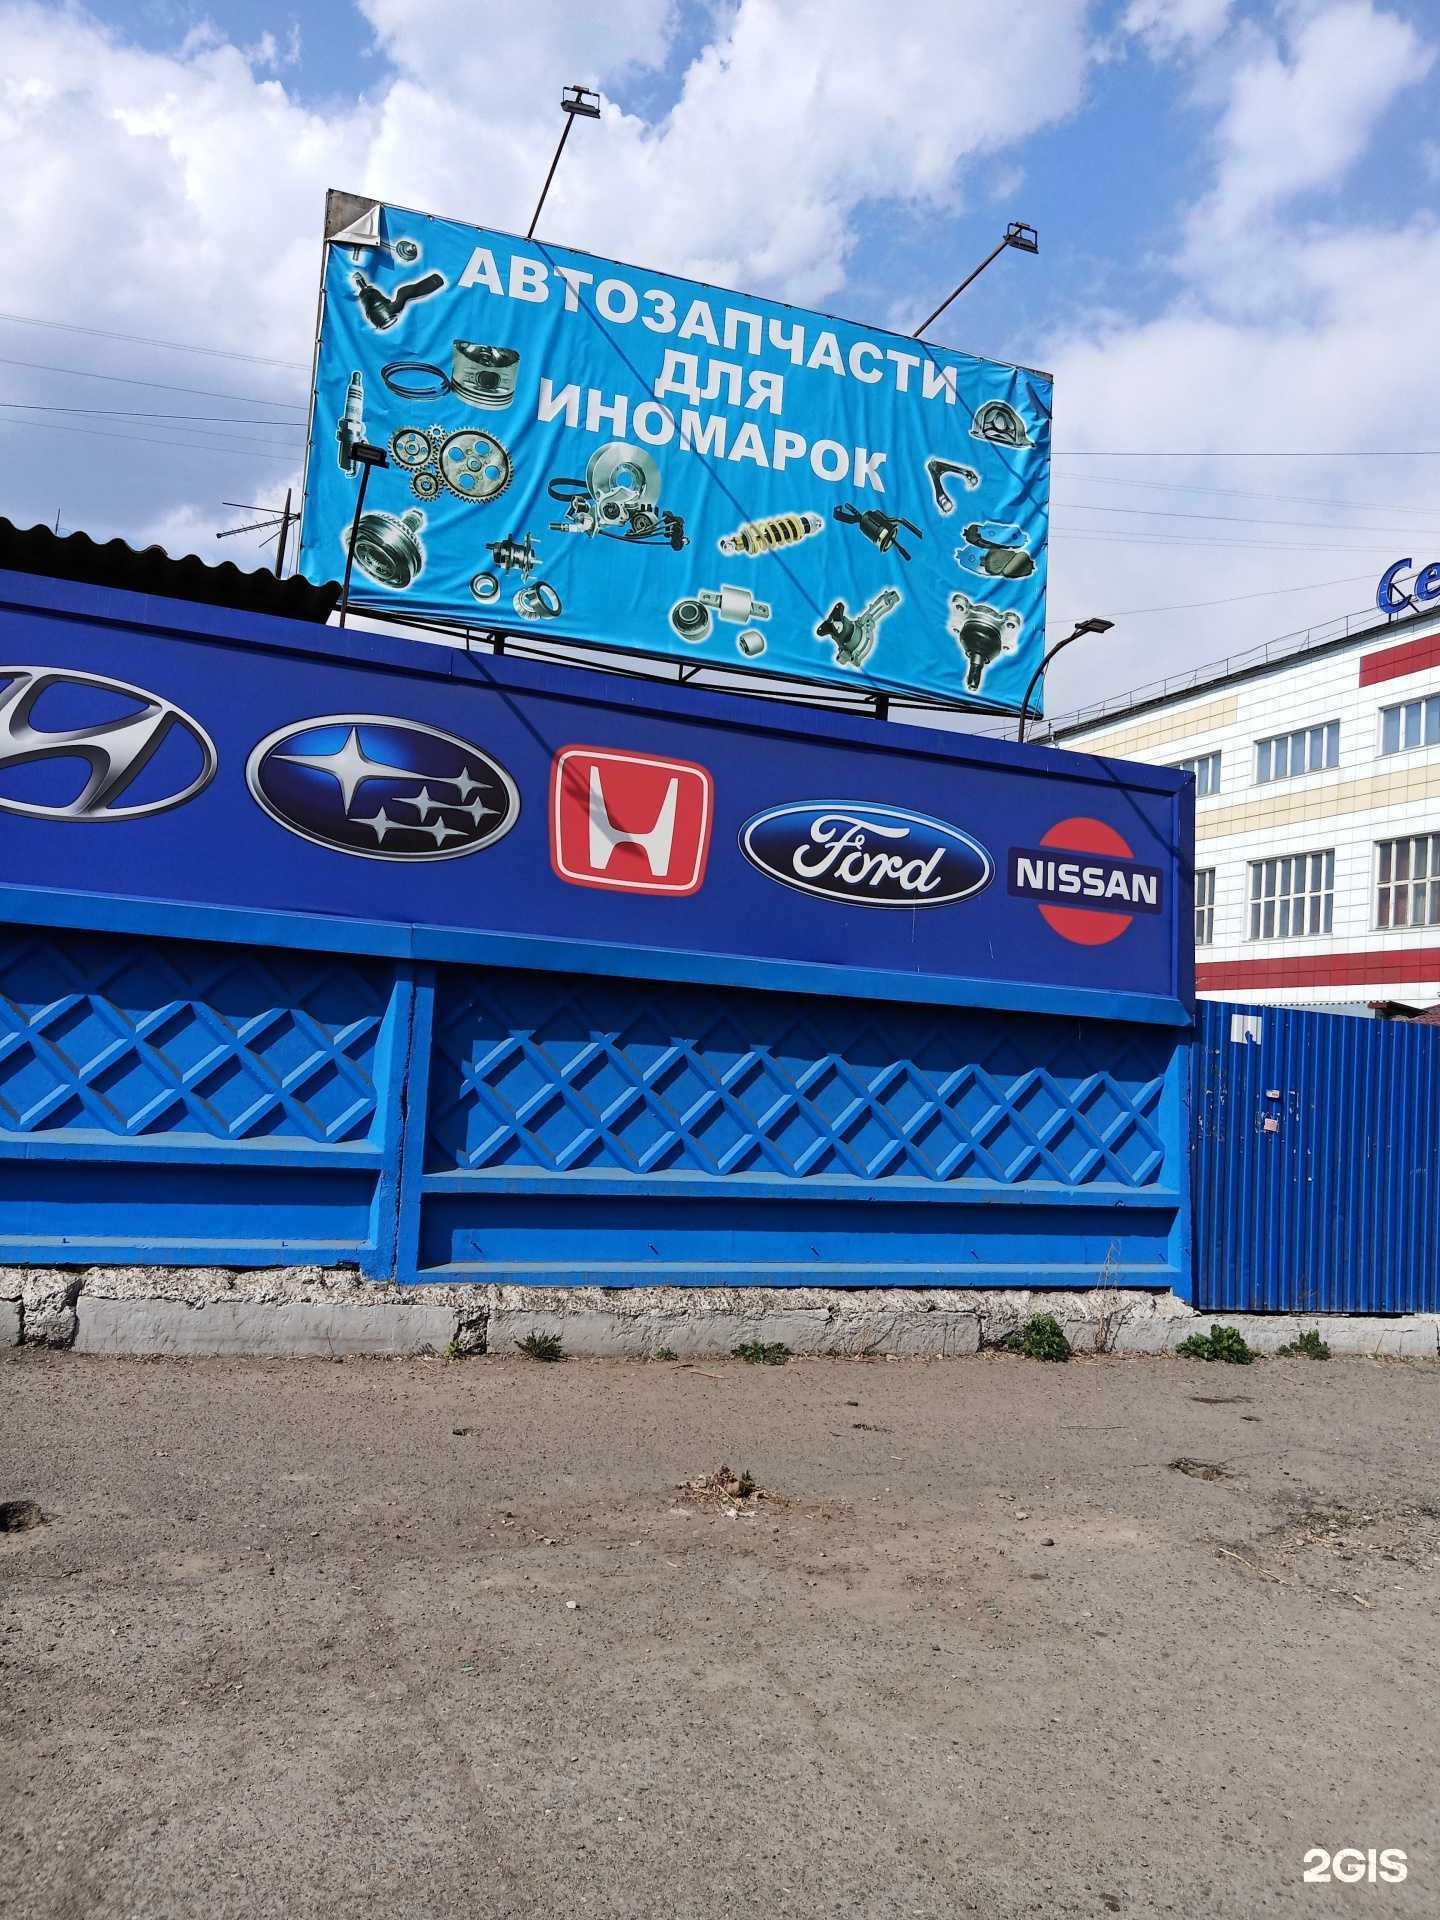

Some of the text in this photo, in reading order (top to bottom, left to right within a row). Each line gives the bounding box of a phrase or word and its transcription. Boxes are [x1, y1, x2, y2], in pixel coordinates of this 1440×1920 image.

[458, 247, 958, 405] АВТОЗАПЧАСТИ
[655, 349, 784, 415] ДЛЯ
[537, 377, 887, 493] ИНОМАРОК
[792, 814, 947, 893] Ford
[1016, 857, 1158, 904] NISSAN
